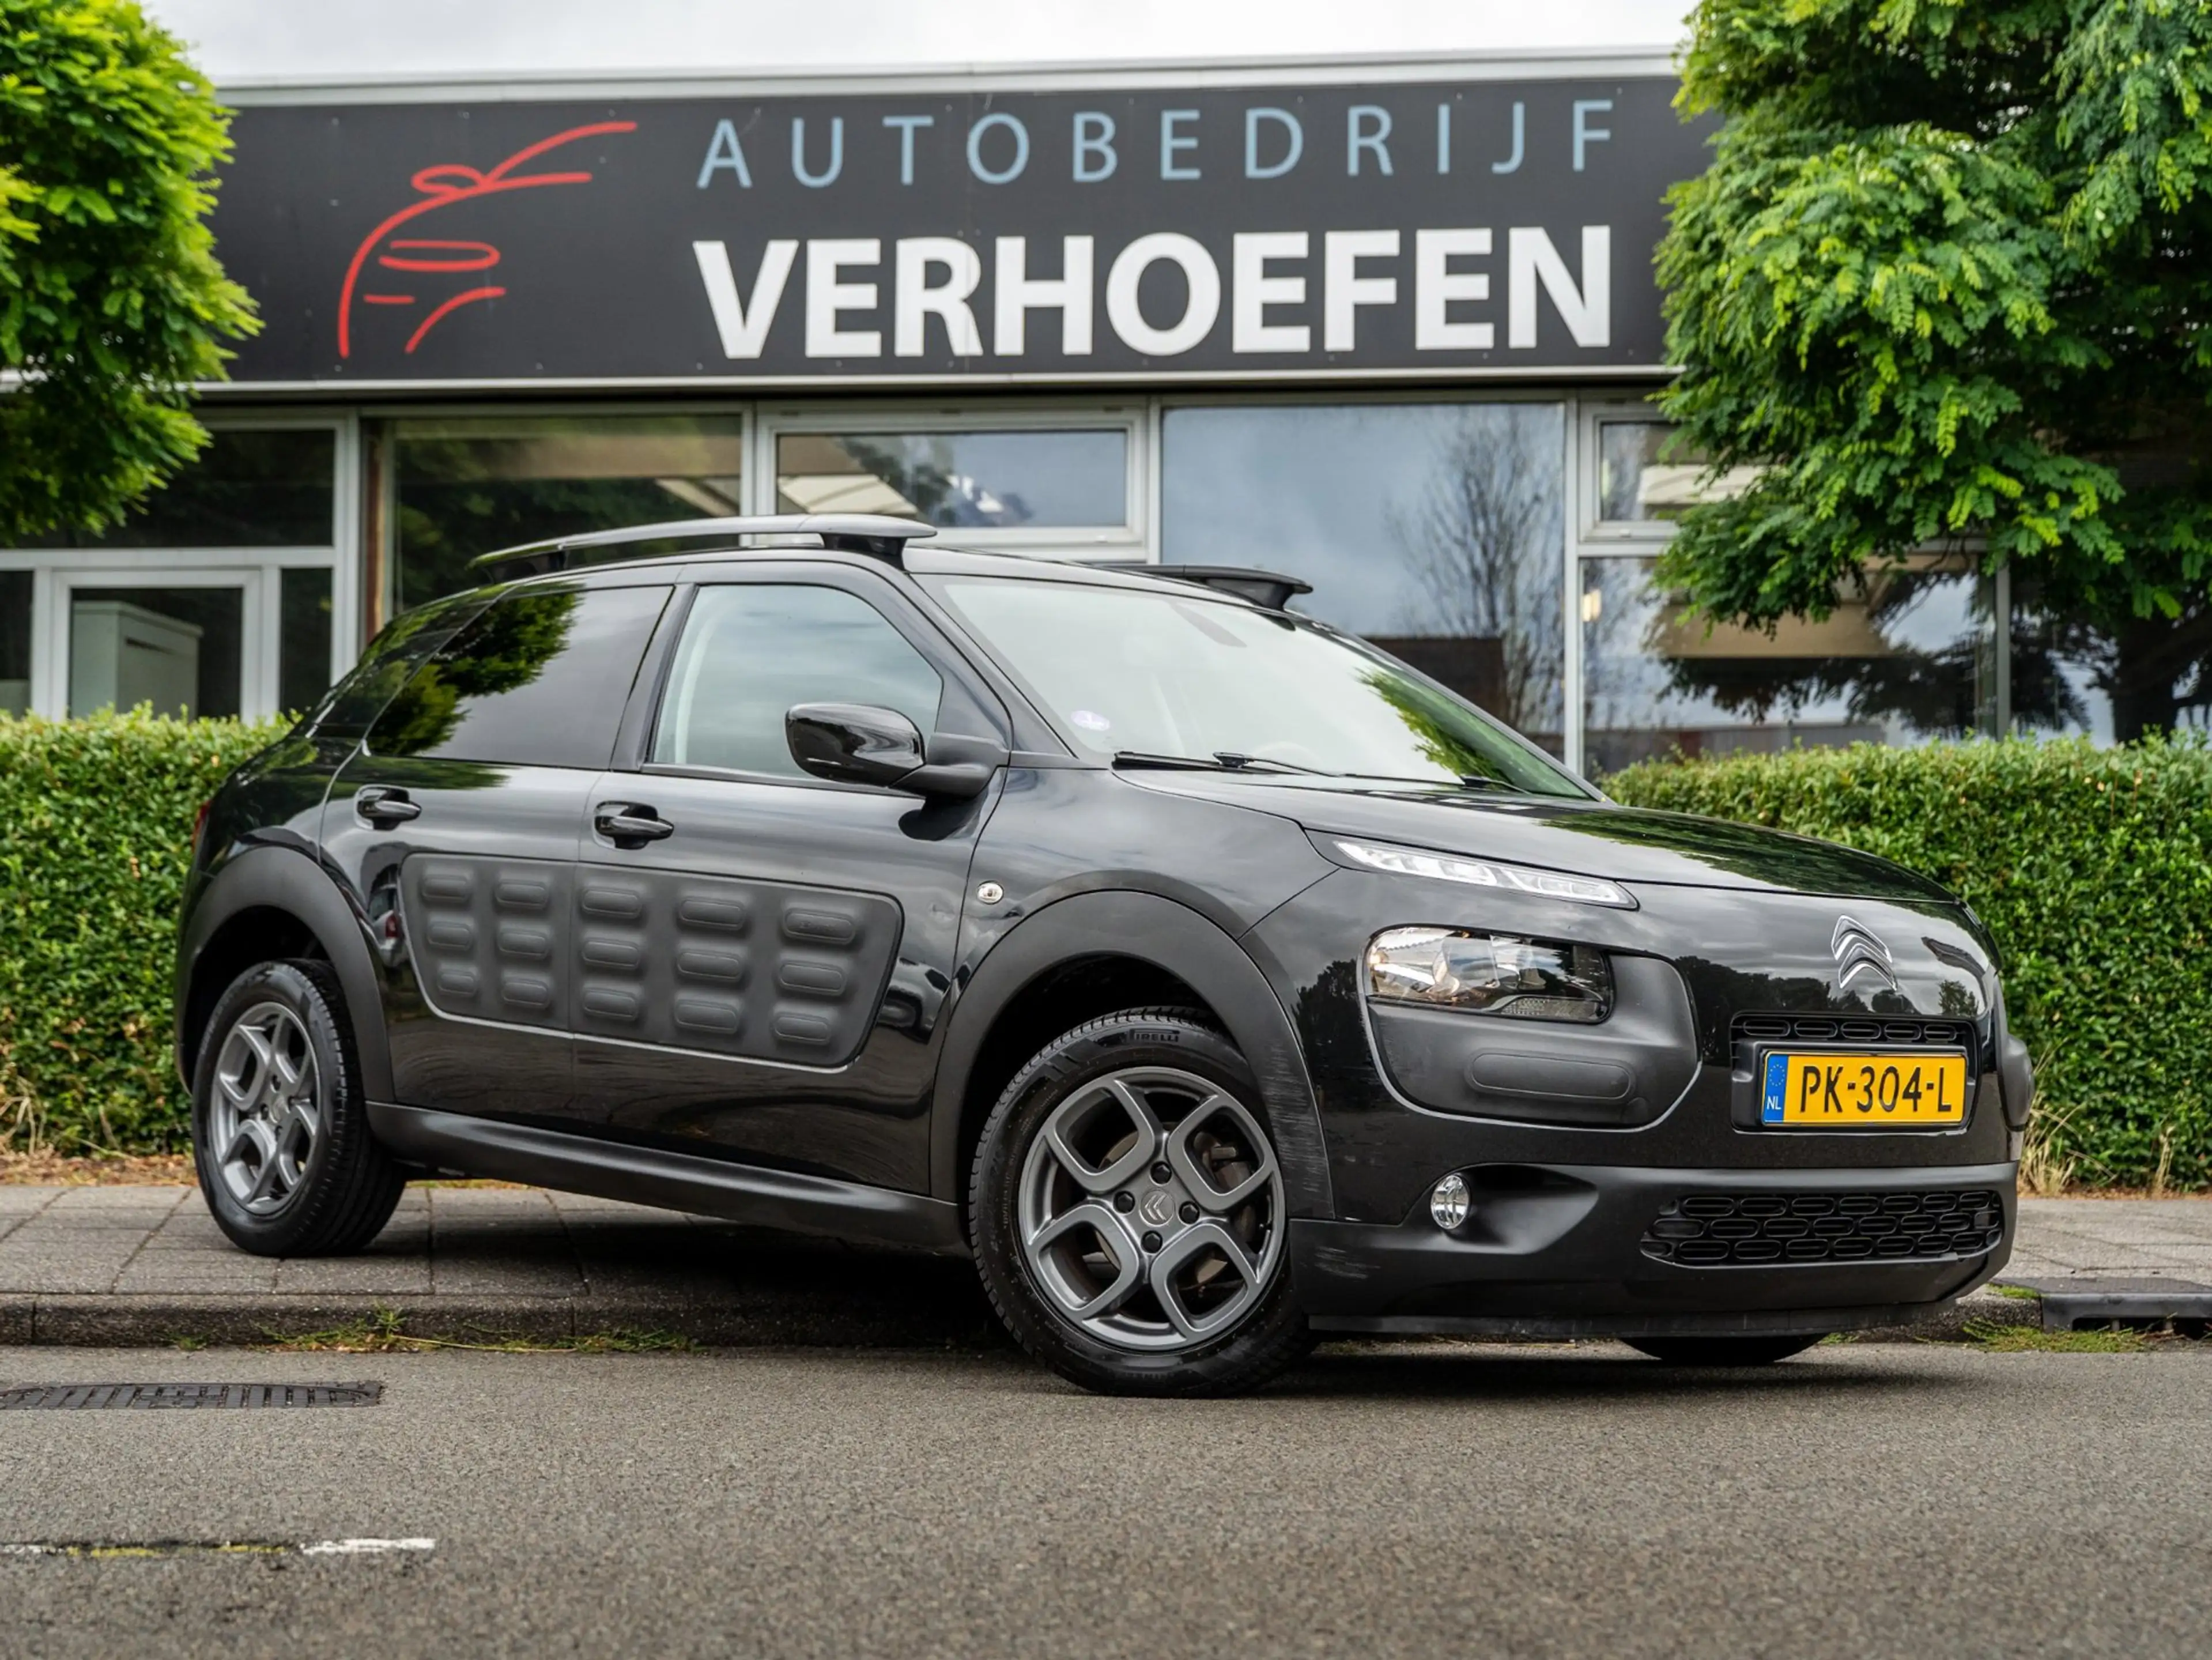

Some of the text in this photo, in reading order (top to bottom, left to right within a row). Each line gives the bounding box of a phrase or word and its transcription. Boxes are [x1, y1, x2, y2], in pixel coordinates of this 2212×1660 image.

[695, 97, 1615, 190] AUTOBEDRIJF
[692, 225, 1611, 360] VERHOEFEN
[1766, 1096, 1781, 1110] NL
[1800, 1065, 1952, 1113] PK-304-L
